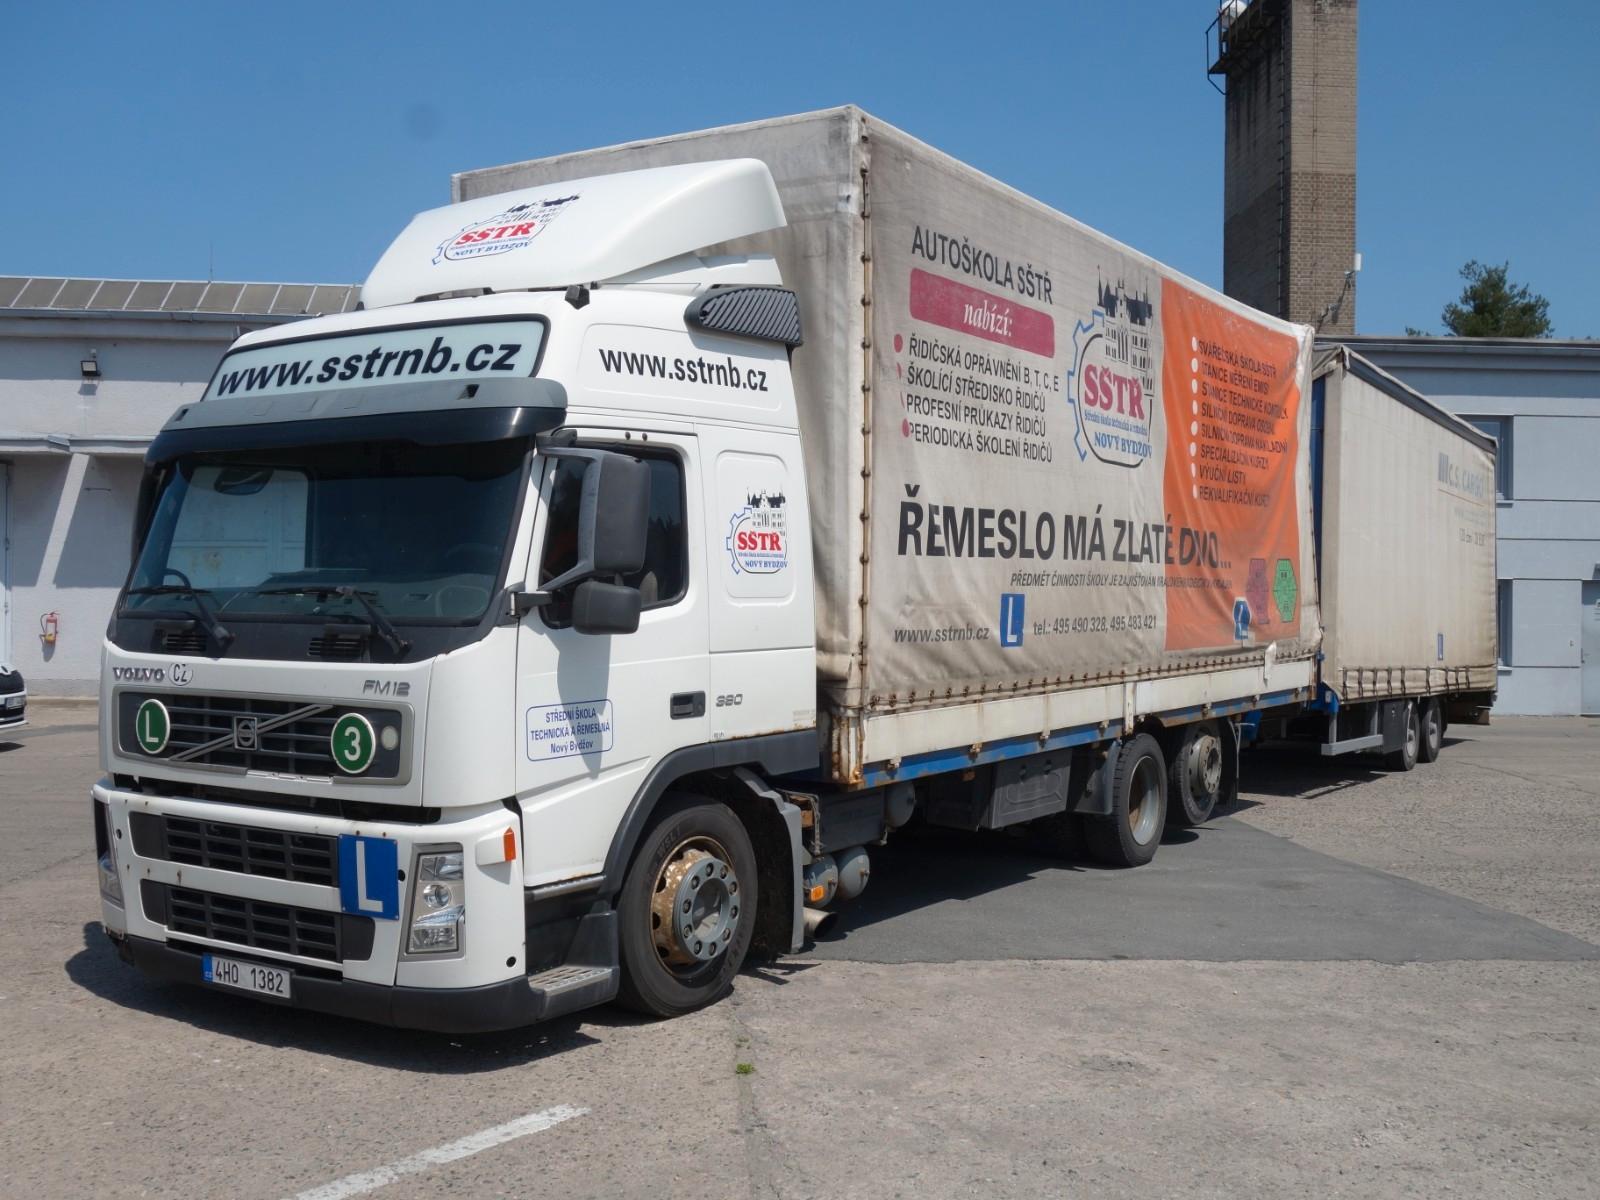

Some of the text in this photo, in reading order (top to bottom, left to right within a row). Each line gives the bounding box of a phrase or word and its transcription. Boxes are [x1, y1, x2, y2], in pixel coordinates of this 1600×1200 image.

[911, 225, 1053, 305] AUTOŠKOLA SŠTŘ
[963, 299, 1013, 337] nabízí:
[217, 337, 522, 397] www.sstrnb.cz
[599, 348, 768, 391] www.sstrnb.cz
[909, 333, 962, 368] ŘIDIČSKÁ
[964, 352, 1021, 382] OPRÁVNĚNÍ
[1053, 375, 1060, 392] E
[907, 361, 1046, 413] ŠKOLÍCÍ STŘEDISKO ŘIDIČŮ
[1084, 364, 1145, 420] SŠTŘ
[906, 394, 1046, 437] PROFESNÍ PRŮKAZY ŘIDIČŮ
[976, 430, 1021, 458] ŠKOLENÍ
[1023, 437, 1052, 463] ŘIDIČŮ
[738, 530, 781, 551] SŠTŘ
[898, 483, 1056, 561] ŘEMESLO
[1063, 504, 1106, 561] MÁ
[1112, 514, 1174, 565] ZLATÉ
[1010, 571, 1050, 586] PŘEDMĚT
[1051, 571, 1086, 586] ČINNOSTI
[1086, 571, 1109, 586] ŠKOLY
[1109, 573, 1118, 586] JE
[894, 623, 990, 643] www.sstrnb.cz
[1007, 597, 1017, 643] L
[1033, 615, 1157, 635] tel.: 495 490 328, 495 483 421
[112, 664, 187, 682] VOLVO CZ
[362, 680, 410, 697] FM12
[145, 711, 159, 743] L
[530, 719, 610, 740] TECHNICKÁ A ŘEMESLNÁ
[545, 706, 596, 723] STŘEDNÍ ŠKOLA
[344, 727, 361, 761] 3
[551, 739, 594, 753] Nový Bydžov
[356, 841, 383, 913] L
[251, 968, 284, 993] 1382
